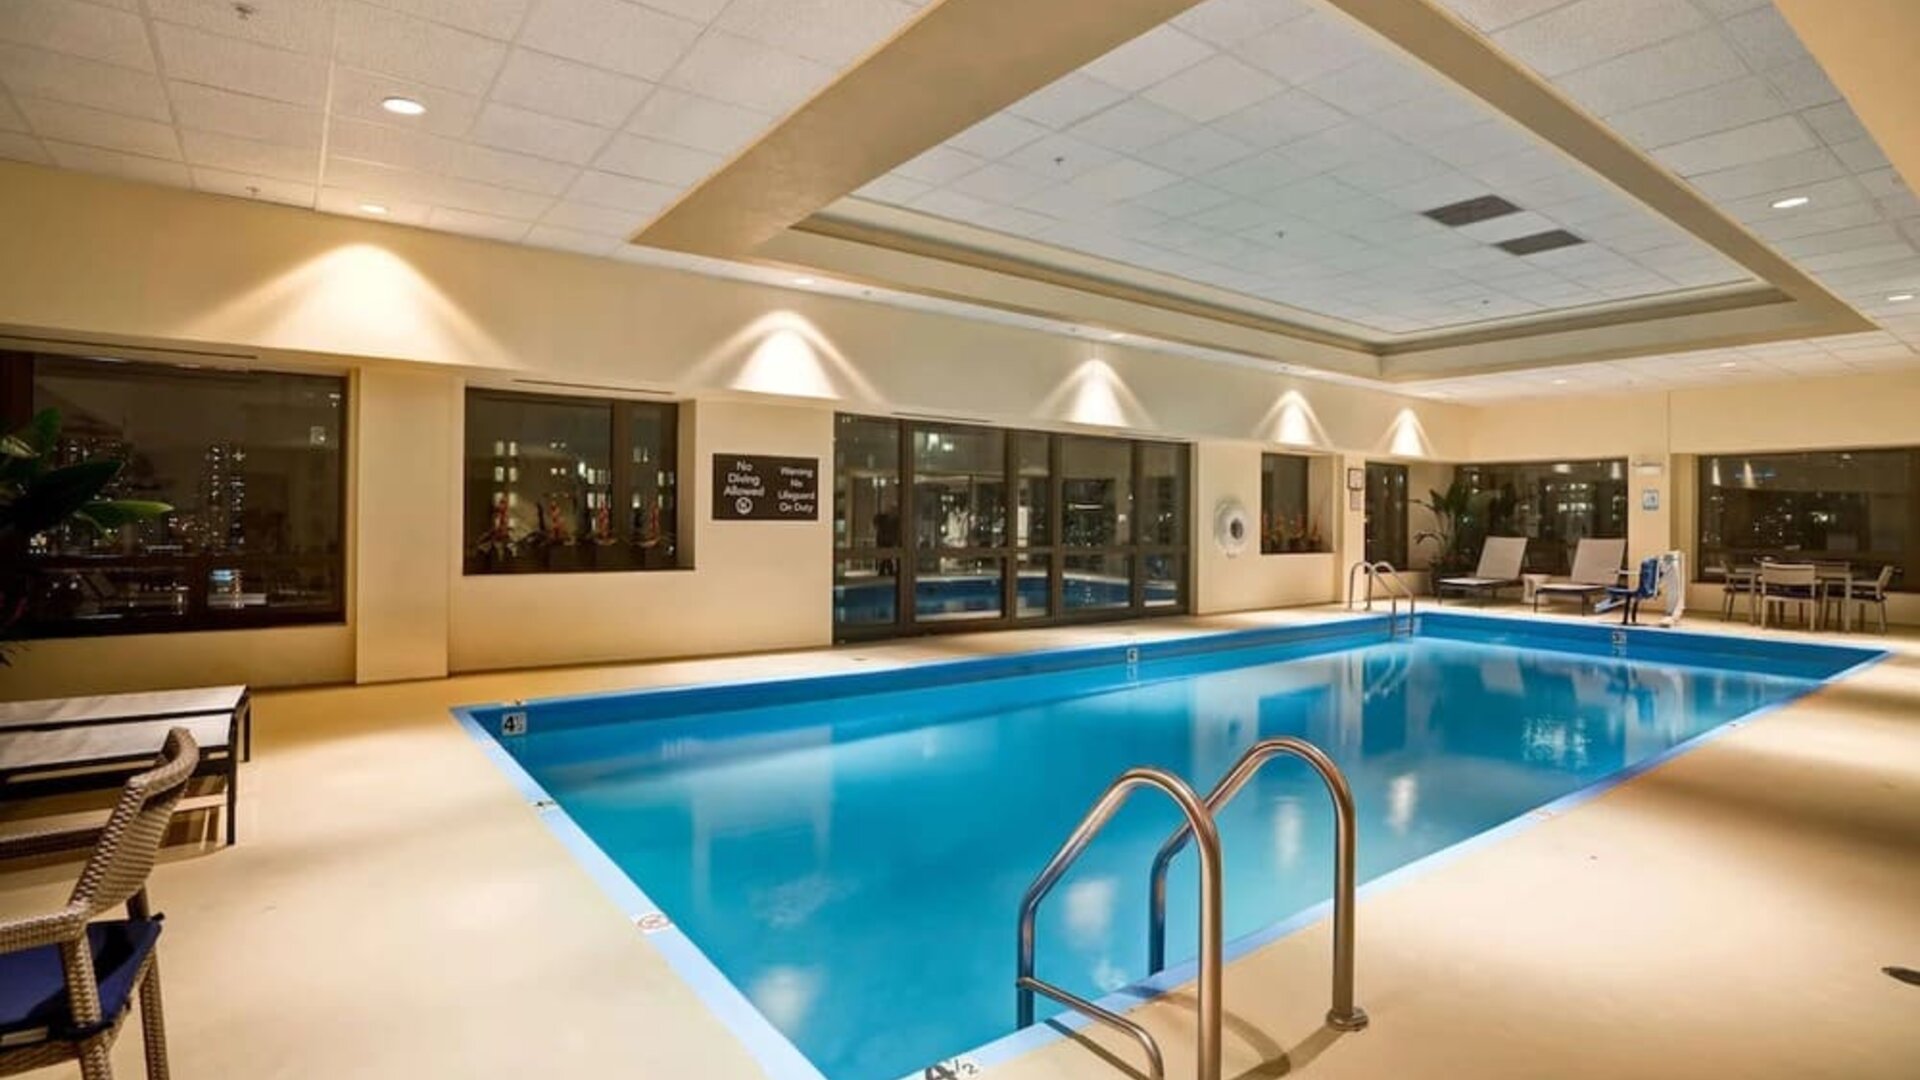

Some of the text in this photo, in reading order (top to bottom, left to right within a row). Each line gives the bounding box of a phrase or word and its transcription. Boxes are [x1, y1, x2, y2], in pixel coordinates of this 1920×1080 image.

[736, 460, 753, 472] No
[727, 472, 761, 487] Diving
[723, 485, 765, 497] Allowed
[794, 502, 814, 513] Duty
